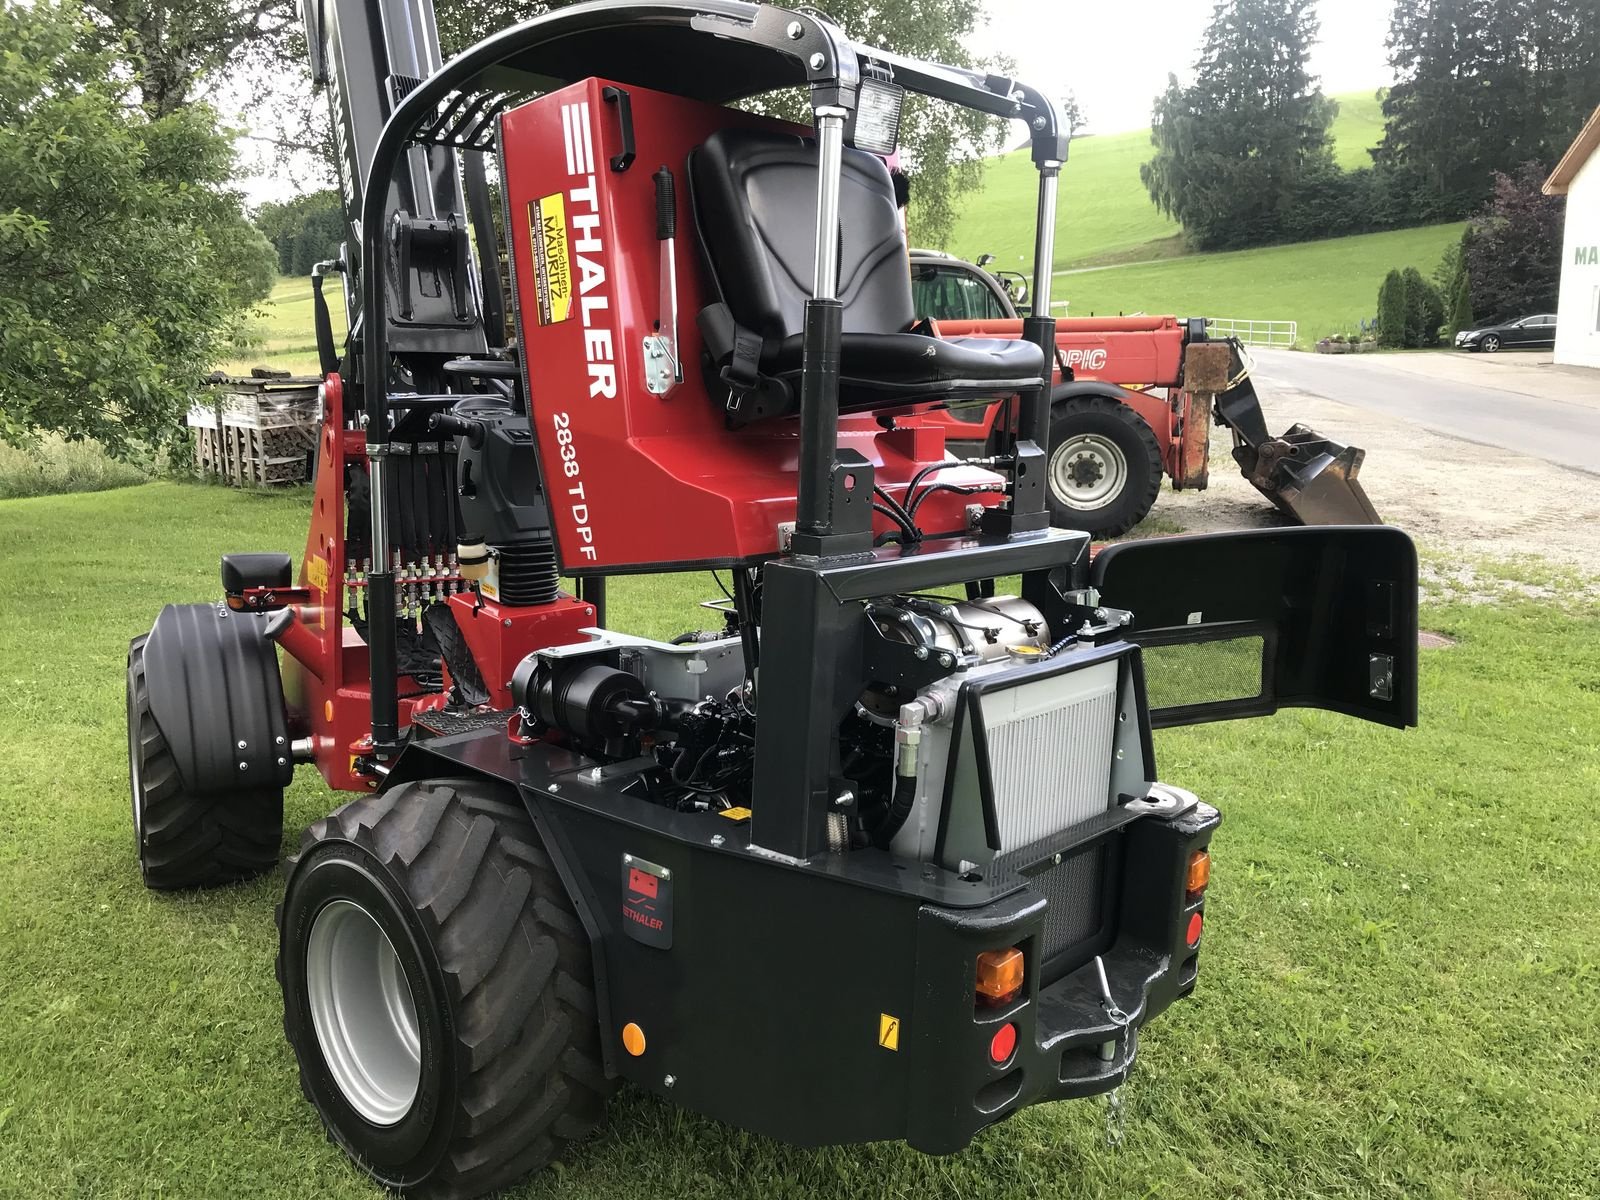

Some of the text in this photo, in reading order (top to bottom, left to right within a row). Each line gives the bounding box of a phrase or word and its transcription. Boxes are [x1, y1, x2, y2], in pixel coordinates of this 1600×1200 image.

[543, 215, 562, 300] MAURITZ
[1575, 246, 1598, 265] MA
[553, 412, 580, 478] 2838
